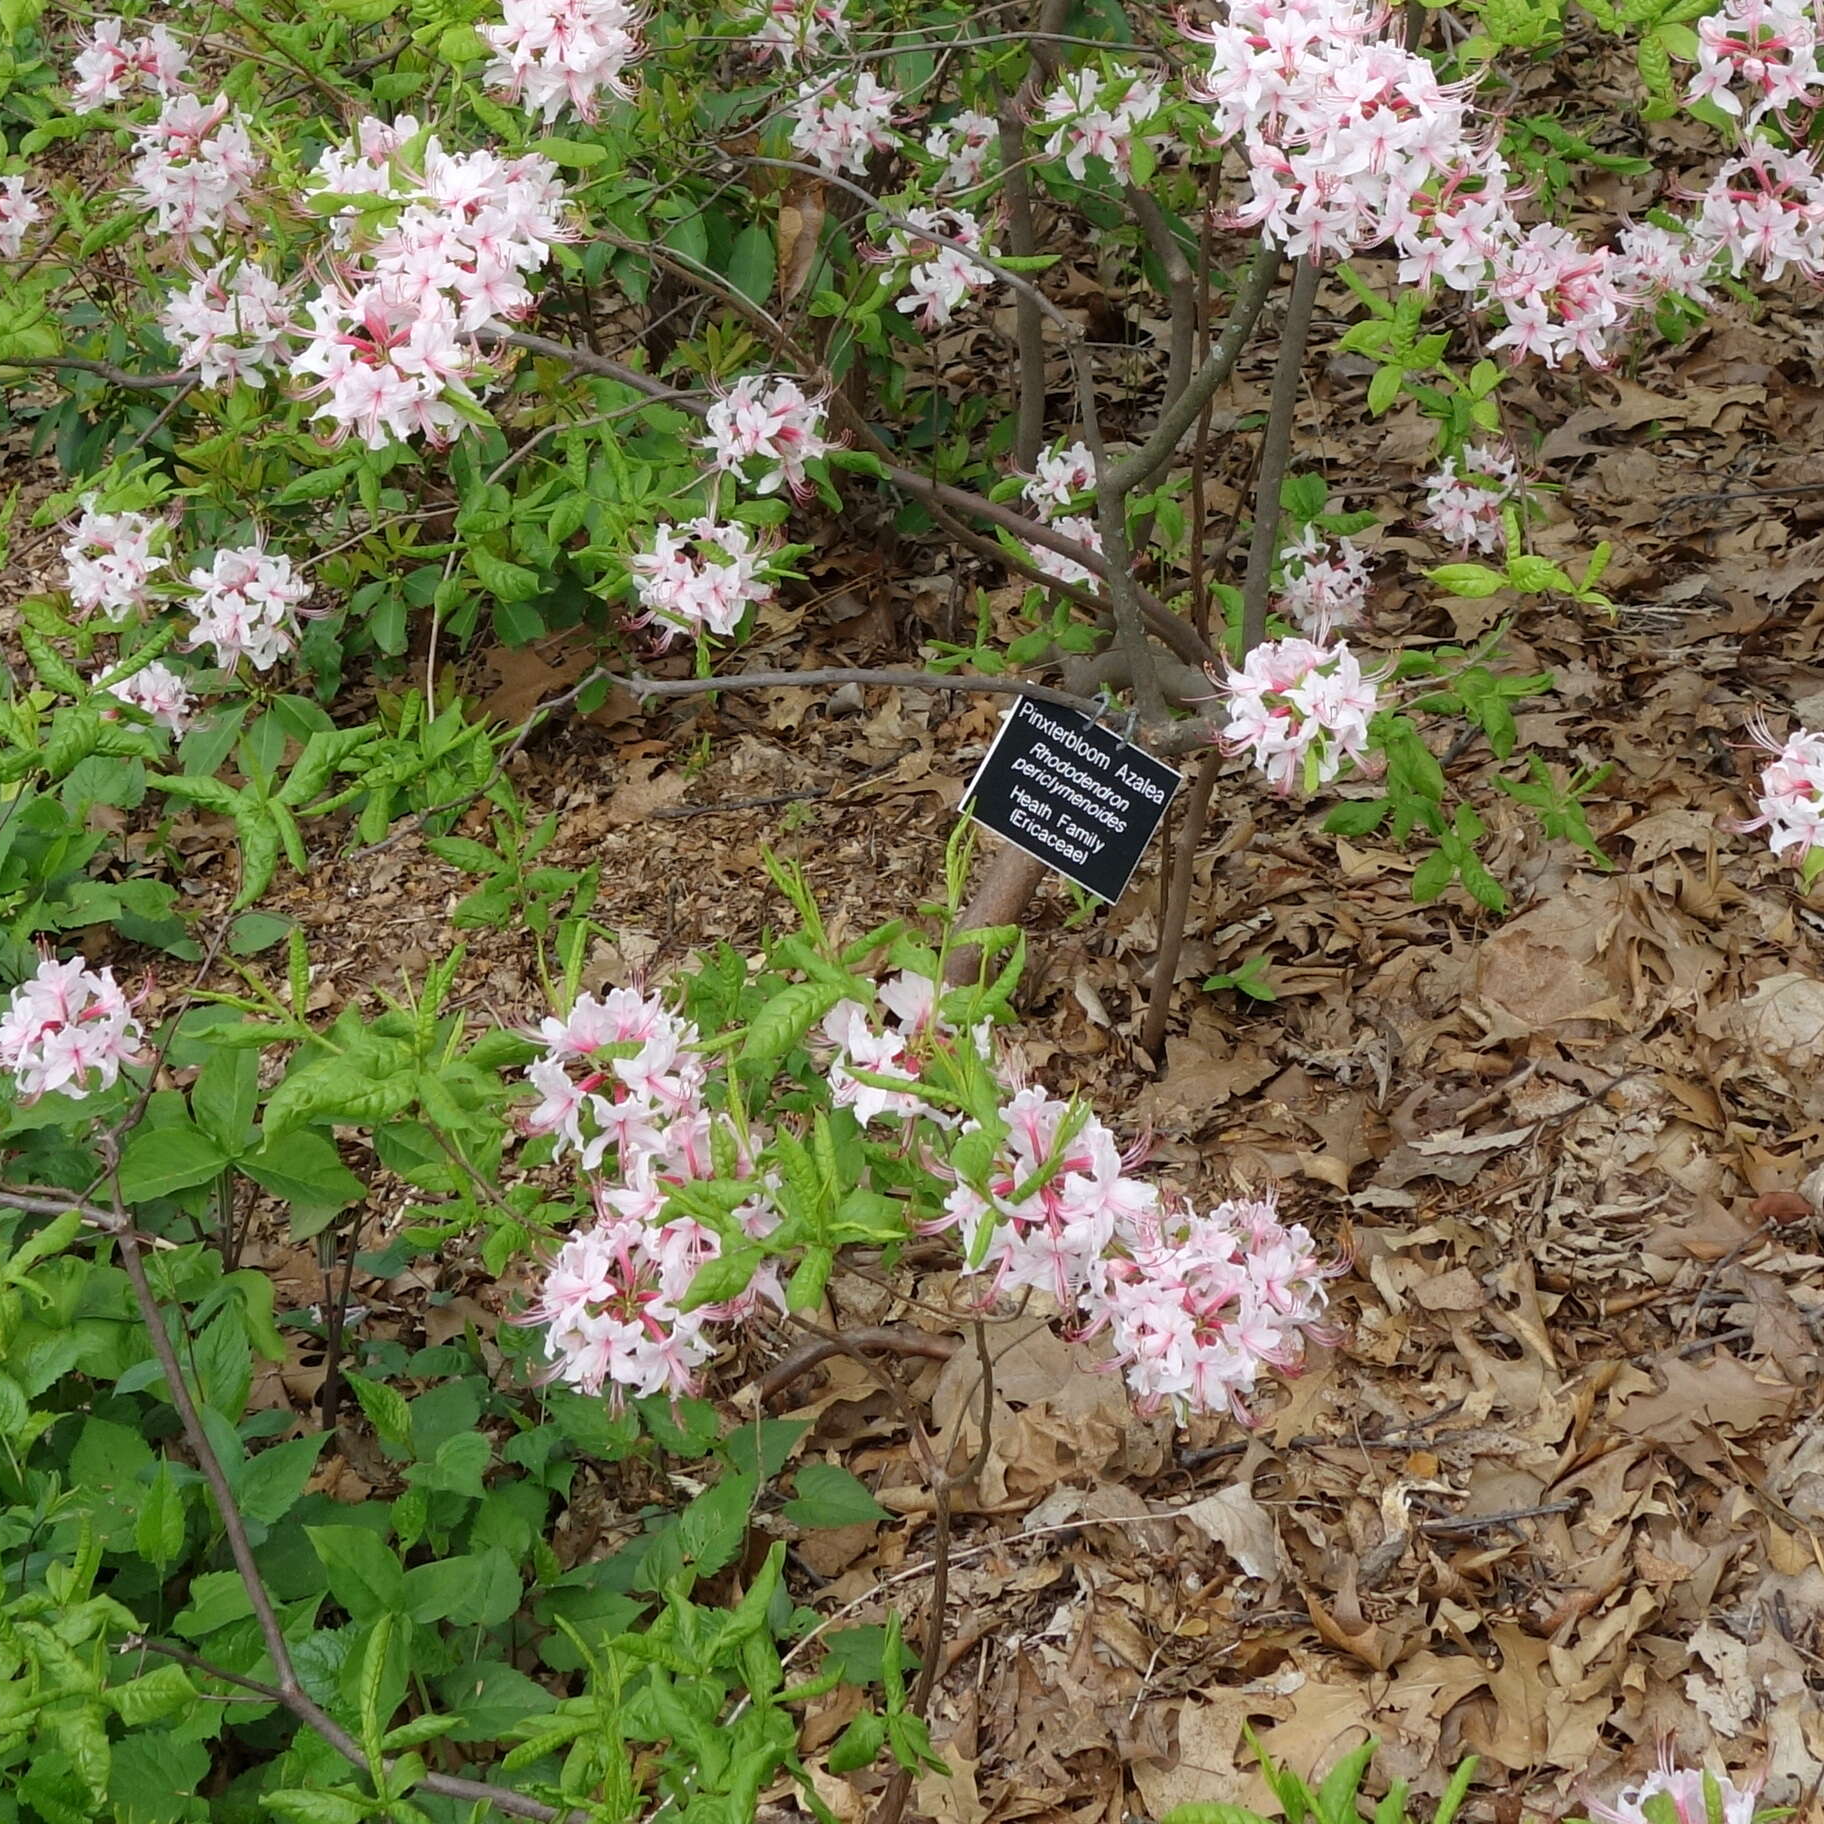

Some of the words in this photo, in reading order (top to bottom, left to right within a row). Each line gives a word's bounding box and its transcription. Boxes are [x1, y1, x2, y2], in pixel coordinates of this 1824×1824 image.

[1018, 701, 1111, 771] Pinxterbloom
[1114, 763, 1166, 805] Azalea
[1029, 742, 1131, 812] Rhododendron
[1009, 784, 1053, 822] Heath
[1056, 815, 1106, 854] Family
[1010, 757, 1128, 834] periclymenoides
[1009, 808, 1089, 866] (Ericaceae)
